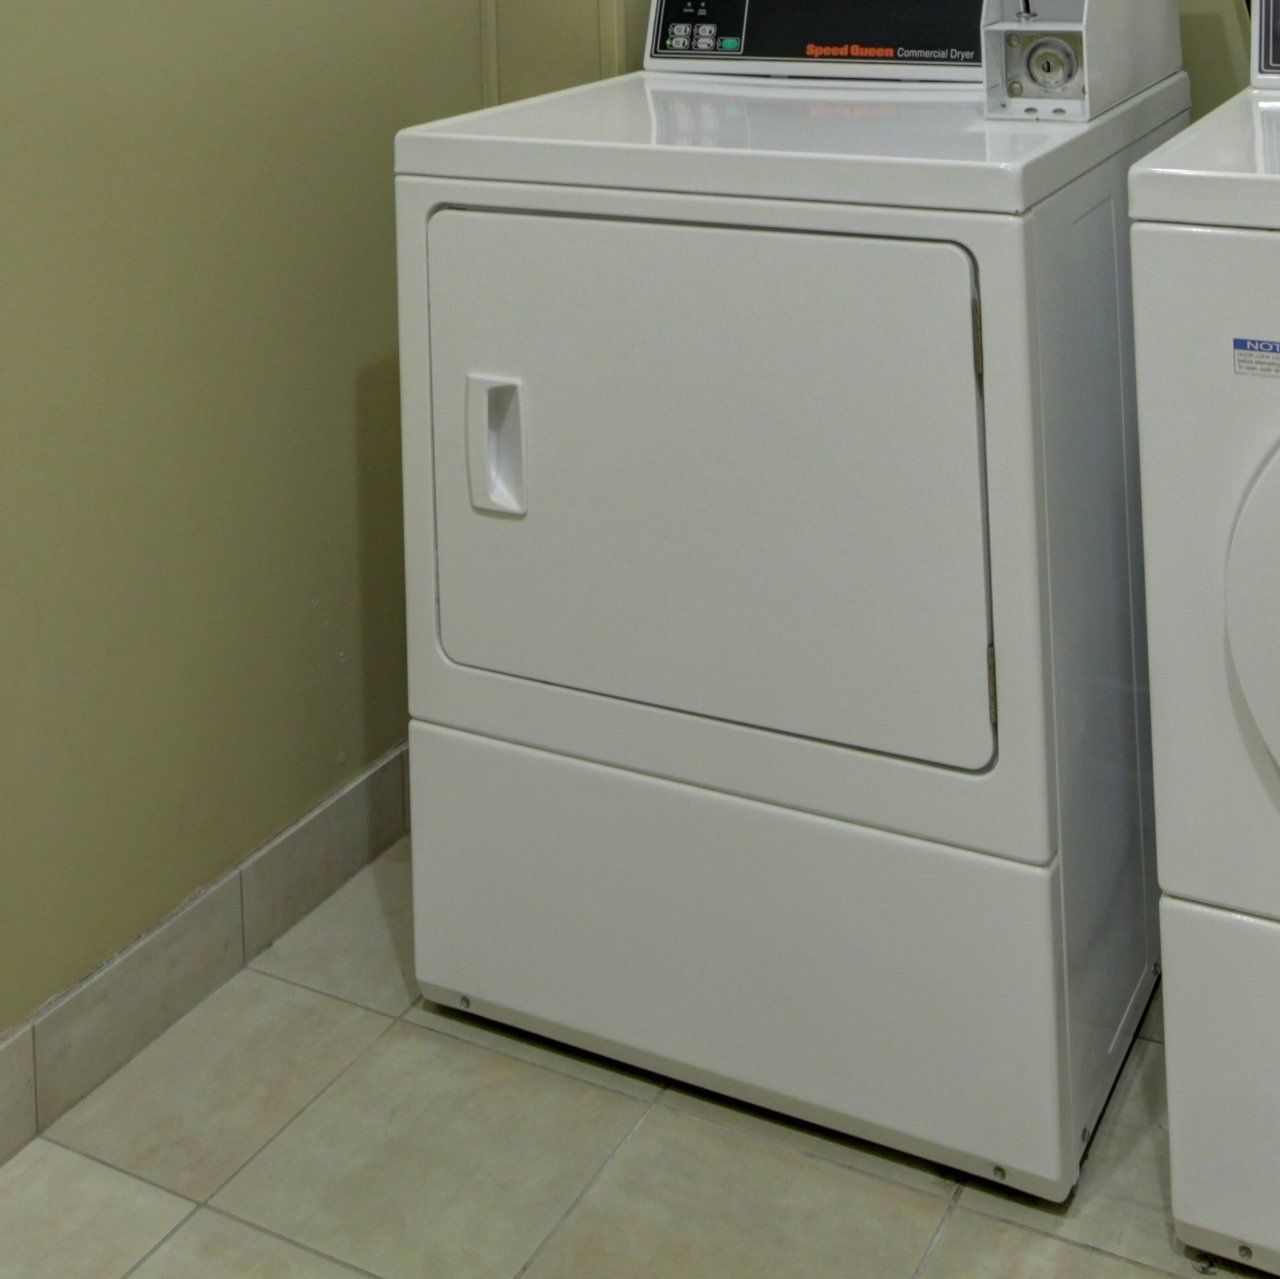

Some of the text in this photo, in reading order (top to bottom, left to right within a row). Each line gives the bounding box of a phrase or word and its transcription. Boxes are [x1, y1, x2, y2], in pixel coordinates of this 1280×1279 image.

[805, 43, 975, 61] Speed Queen Commercial Dryer
